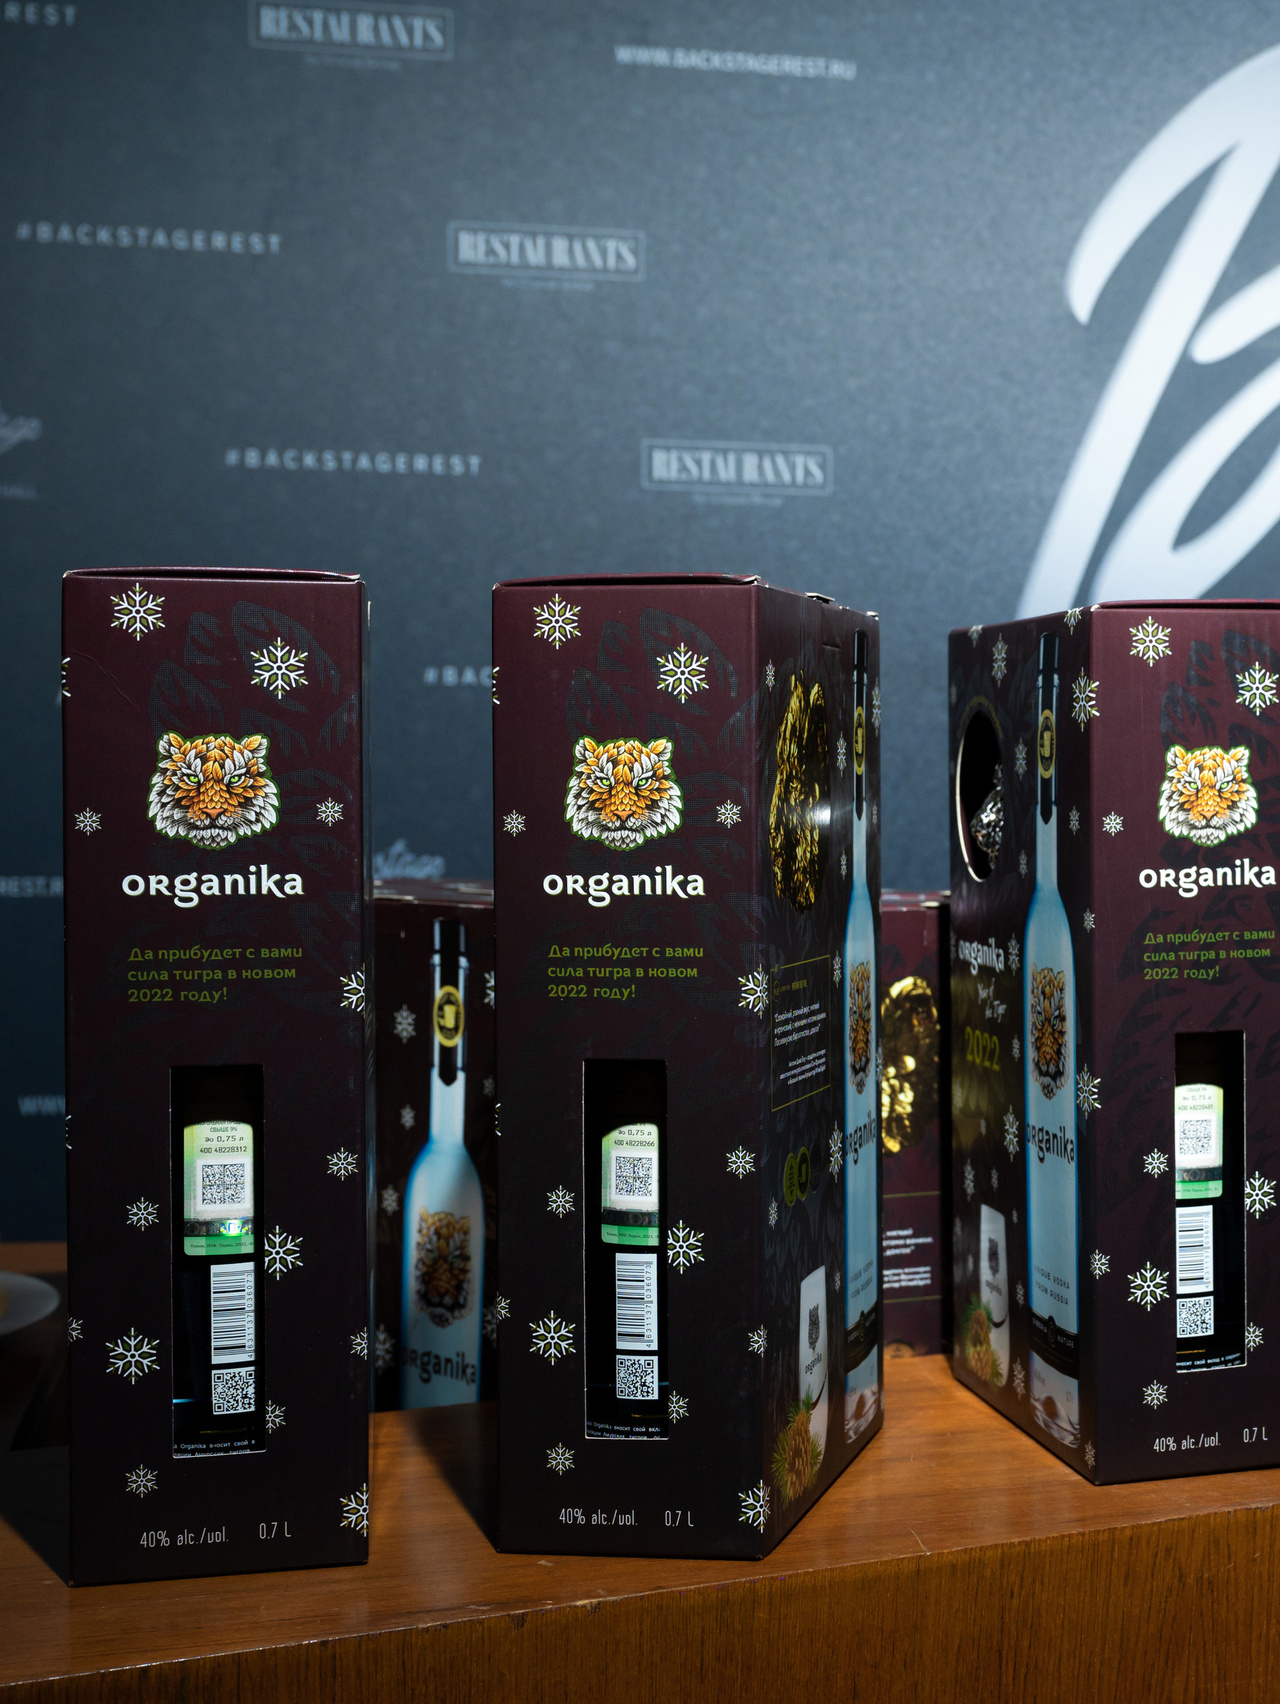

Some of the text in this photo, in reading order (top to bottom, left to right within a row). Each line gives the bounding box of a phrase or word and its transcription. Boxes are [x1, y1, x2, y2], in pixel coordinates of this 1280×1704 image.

[16, 221, 282, 255] #BACKSTAGEREST
[225, 447, 483, 476] #BACKSTAGEREST
[1143, 929, 1276, 945] Да прибудет с вами
[127, 944, 303, 962] Да прибудет с вами
[547, 942, 704, 960] Да прибудет с вами
[1143, 948, 1271, 963] сила тигра в новом
[128, 968, 296, 982] сила тигра в новом
[547, 967, 698, 980] сила тигра в новом
[1144, 965, 1220, 980] 2022 году!
[128, 986, 228, 1004] 2022 году!
[548, 984, 636, 1000] 2022 году!
[965, 1026, 1000, 1072] 2022
[1153, 1437, 1177, 1452] 40%
[1243, 1427, 1258, 1443] 0.7
[559, 1508, 586, 1525] 40%
[664, 1510, 682, 1527] 0.7
[140, 1531, 170, 1548] 40%
[259, 1521, 278, 1539] 0.7
